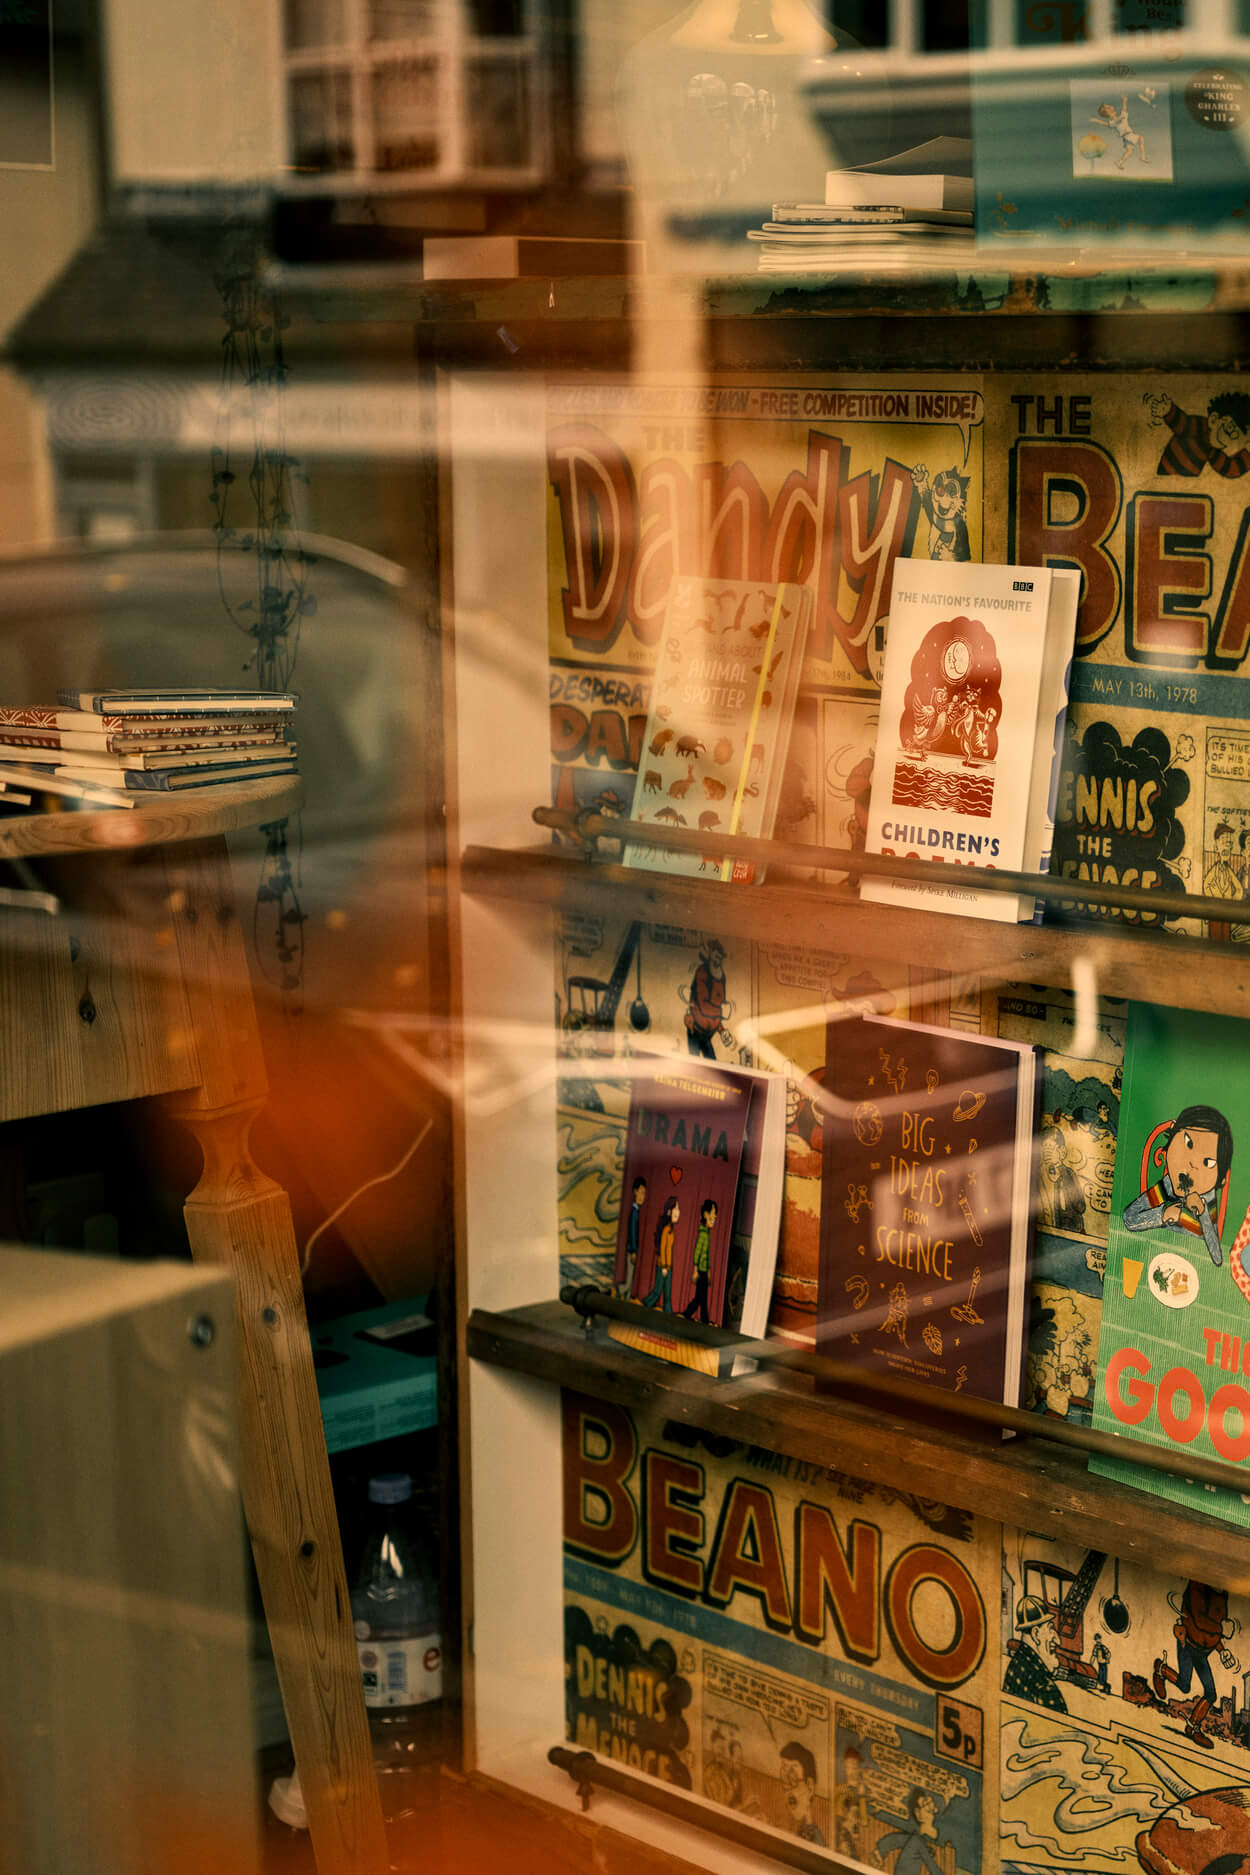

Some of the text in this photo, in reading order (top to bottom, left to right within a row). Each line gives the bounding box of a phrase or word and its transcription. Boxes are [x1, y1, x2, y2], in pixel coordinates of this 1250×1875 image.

[1207, 92, 1234, 101] KING
[1212, 112, 1227, 123] III
[804, 393, 910, 418] COMPETITION
[915, 394, 977, 420] INSIDE!
[1010, 394, 1093, 436] THE
[641, 425, 706, 453] THE
[547, 422, 918, 684] Dandy
[1012, 581, 1035, 592] BBC
[897, 591, 1033, 613] THE NATION'S FAVOURITE
[687, 659, 748, 684] ANIMAL
[680, 686, 747, 710] SPOTTER
[1092, 679, 1198, 704] MAY 13th, 1978
[1211, 752, 1223, 762] OF
[1227, 754, 1243, 765] HIS
[1230, 743, 1250, 754] TIME
[1210, 763, 1244, 776] BULLIED
[1059, 768, 1162, 838] ENNIS
[881, 821, 1000, 857] CHILDREN'S
[1076, 833, 1113, 859] THE
[636, 1106, 730, 1163] DRAMA
[901, 1110, 936, 1156] BIG
[889, 1155, 947, 1208] IDEAS
[903, 1207, 930, 1226] FROM
[876, 1225, 955, 1282] SCIENCE
[562, 1399, 988, 1692] BEANO
[577, 1644, 669, 1723] DENNIS
[609, 1713, 638, 1738] THE
[942, 1705, 977, 1761] 5p
